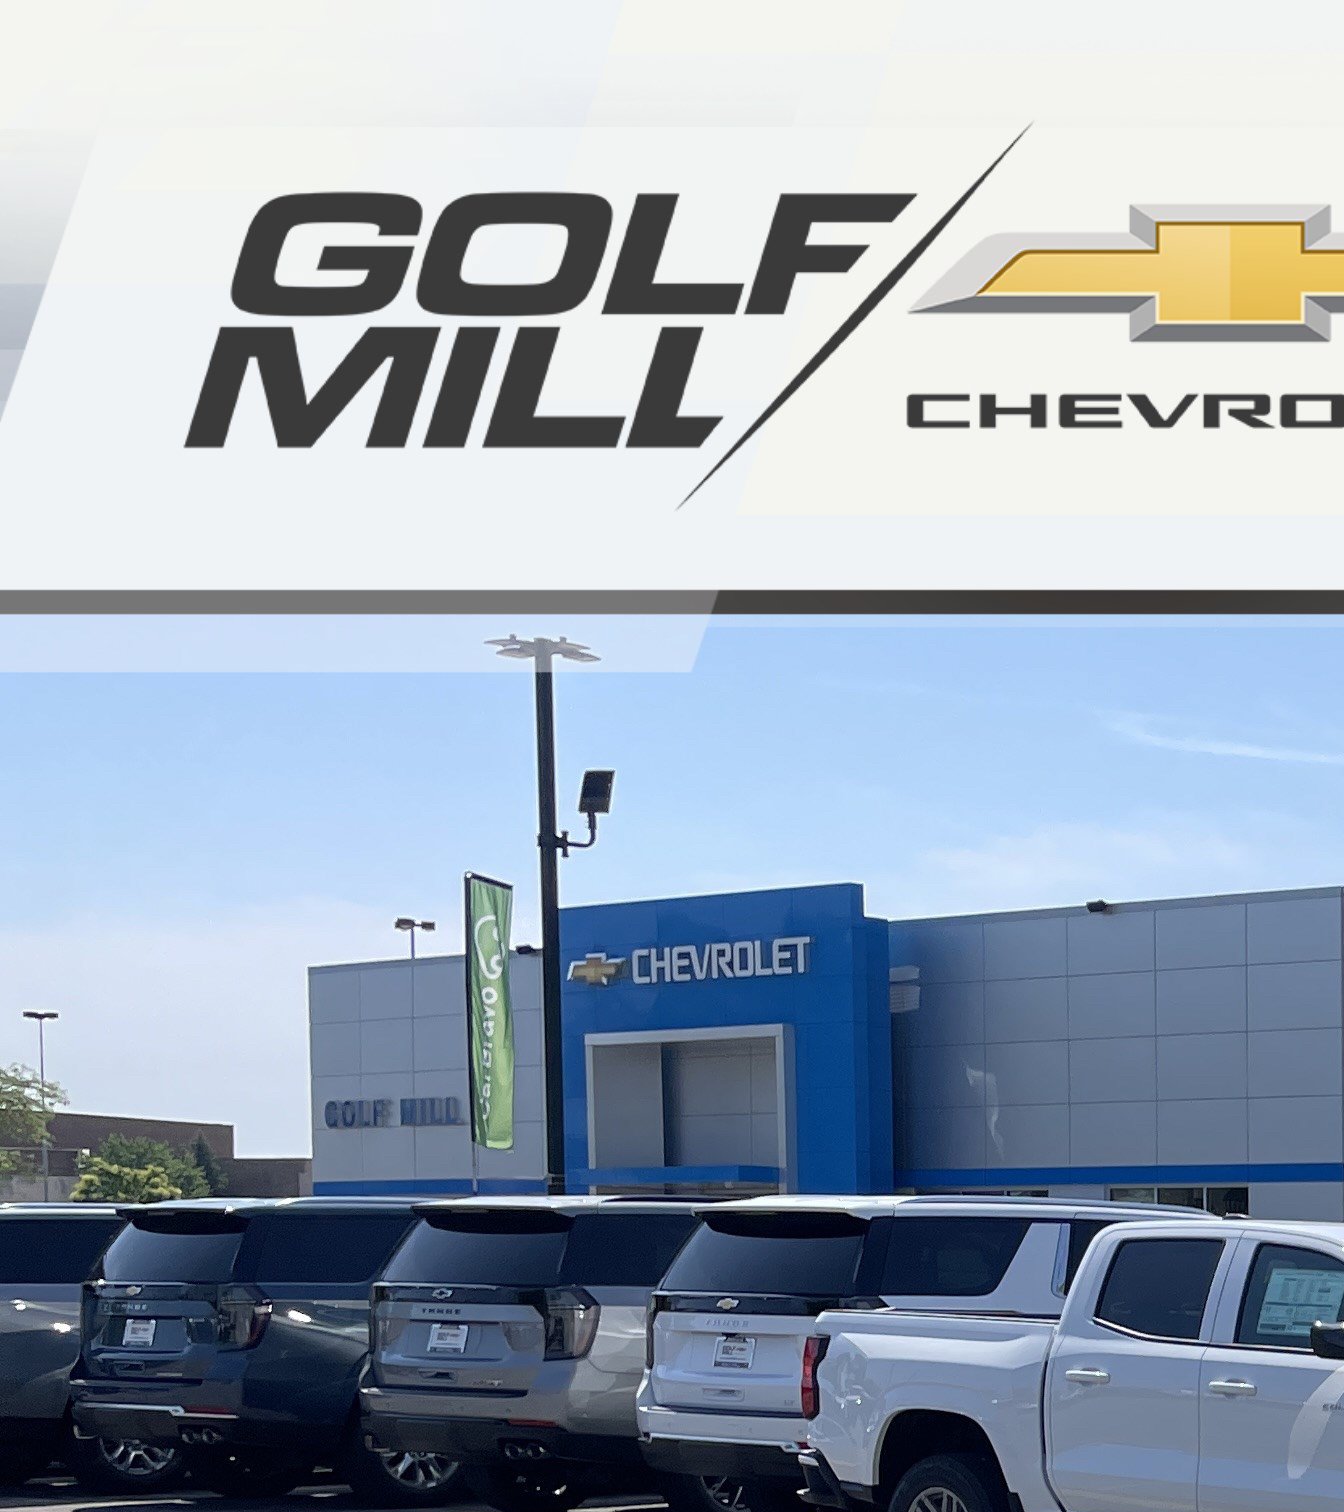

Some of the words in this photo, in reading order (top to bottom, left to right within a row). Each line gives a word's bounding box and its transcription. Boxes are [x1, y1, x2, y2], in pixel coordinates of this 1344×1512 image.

[632, 936, 811, 985] CHEVROLET
[324, 1099, 391, 1128] GOLF
[400, 1096, 462, 1126] MILL
